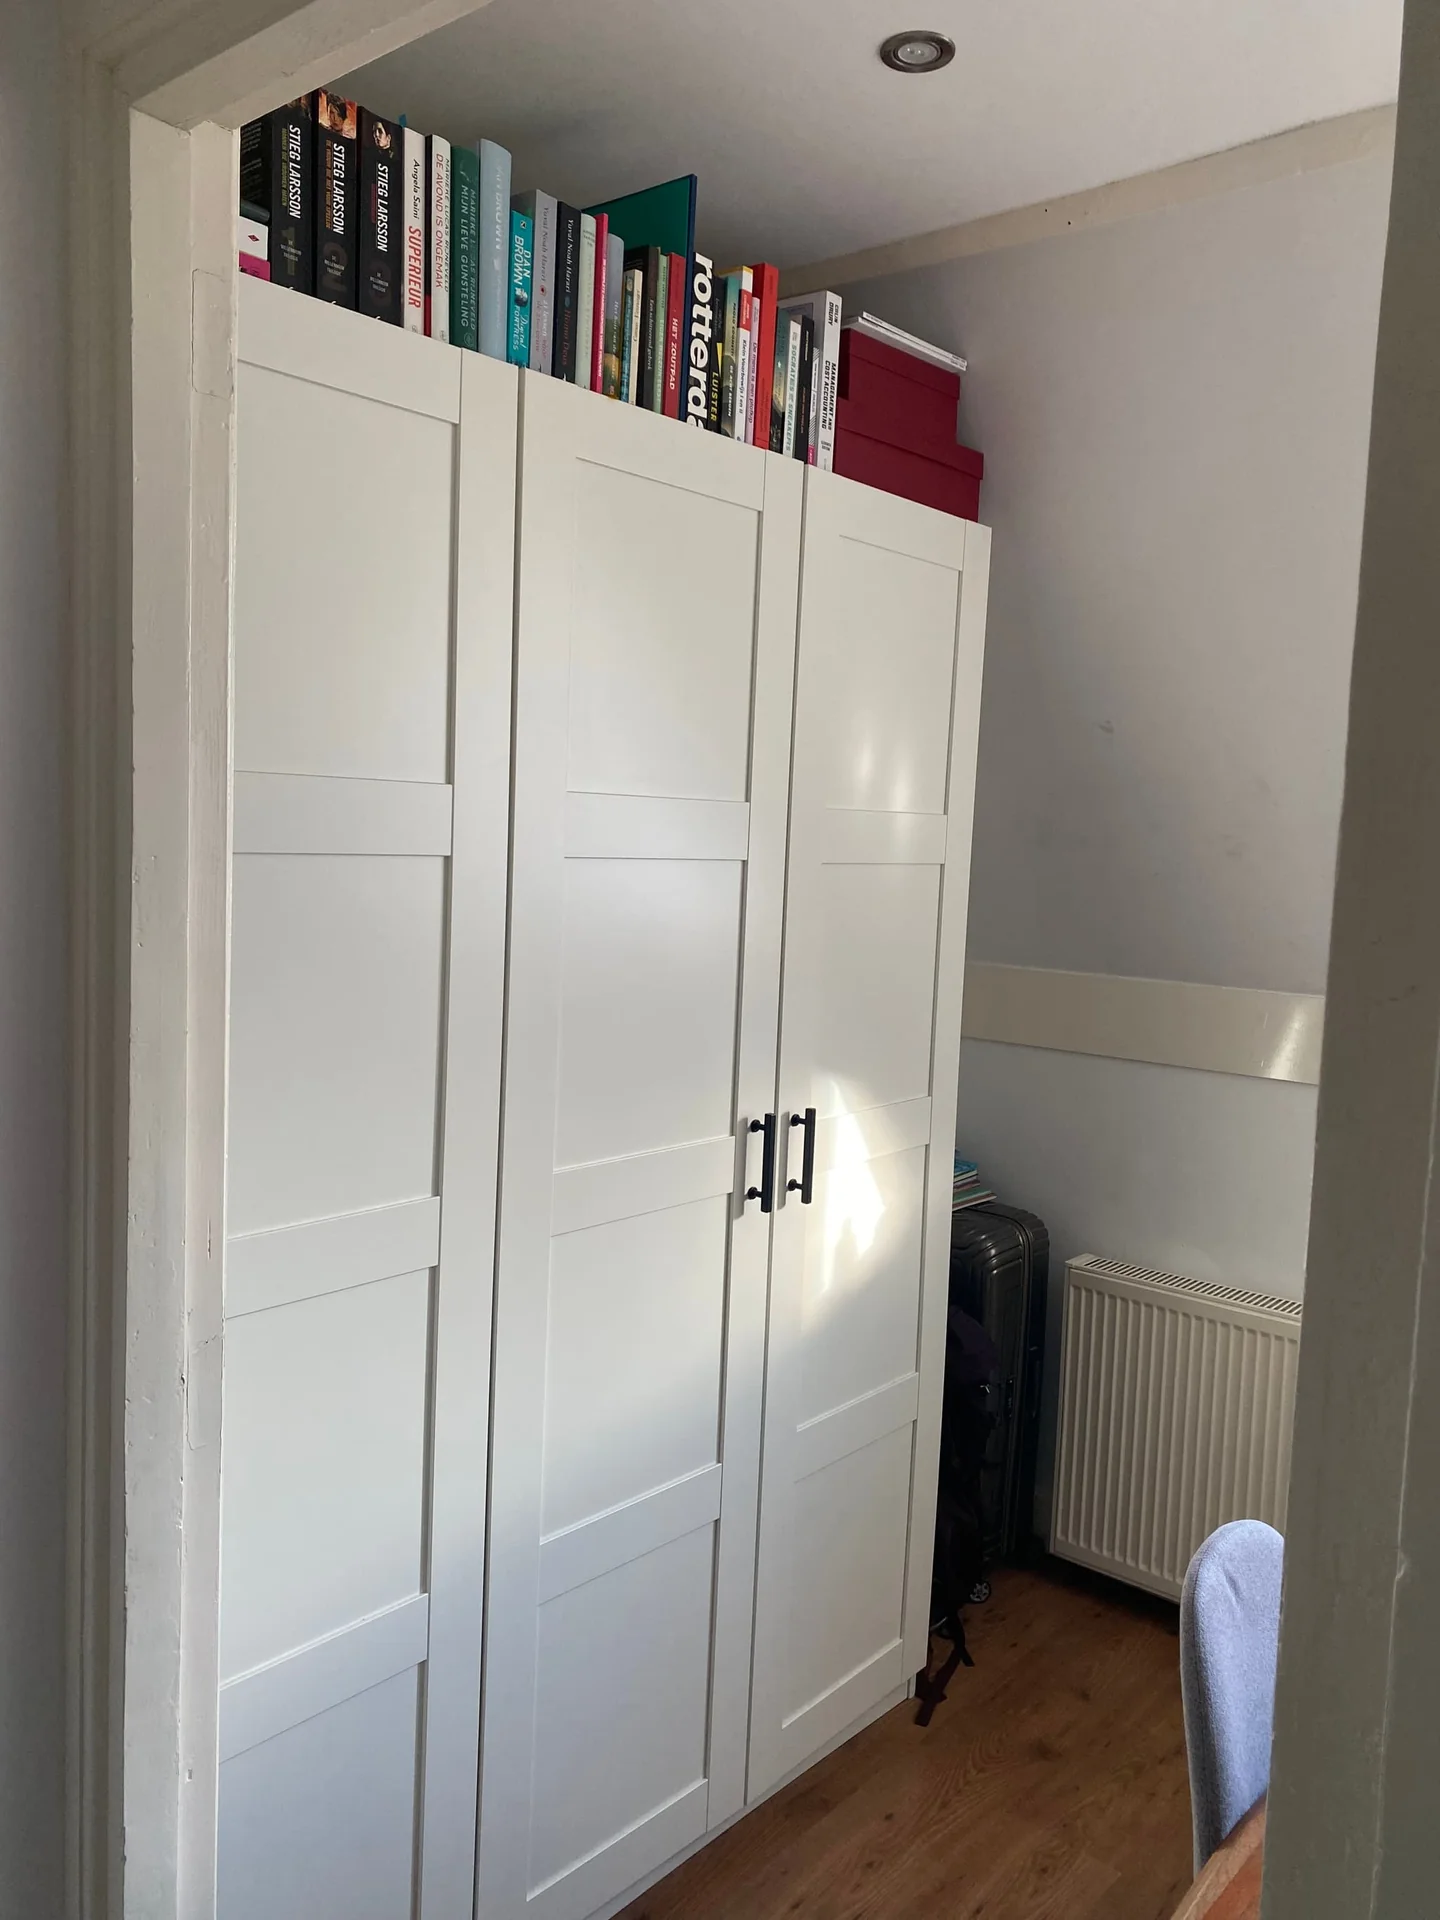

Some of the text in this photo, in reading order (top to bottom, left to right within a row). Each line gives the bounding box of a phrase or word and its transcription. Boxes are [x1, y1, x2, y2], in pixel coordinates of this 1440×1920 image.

[288, 124, 301, 219] STIEG LARSSON
[332, 142, 345, 235] STIEG LARSSON
[411, 159, 421, 219] Angela Saini
[376, 163, 389, 252] STIEG LARSSON
[435, 153, 444, 289] DE AVOND IS ONGEMAK
[469, 189, 477, 236] MARIEKE
[541, 206, 550, 230] Yuval
[408, 225, 422, 309] SUPERIEUR
[460, 184, 469, 328] MIJN LIEVE GUNSTELING
[513, 234, 524, 286] BROWN
[523, 249, 531, 278] DAN
[541, 231, 549, 253] Noah
[564, 218, 574, 293] Yuval Noah Harari
[512, 304, 521, 351] FORTRESS
[519, 314, 529, 349] Digital
[561, 308, 572, 366] Homo Deus
[751, 342, 757, 353] De
[669, 317, 679, 390] HET ZOUTPAD
[789, 344, 797, 392] SOCRATES
[710, 371, 719, 421] LUISTER
[747, 397, 755, 424] plofkip
[821, 381, 830, 430] ACCOUNTING
[828, 362, 837, 418] MANAGEMENT
[785, 403, 794, 452] SNEAKERS
